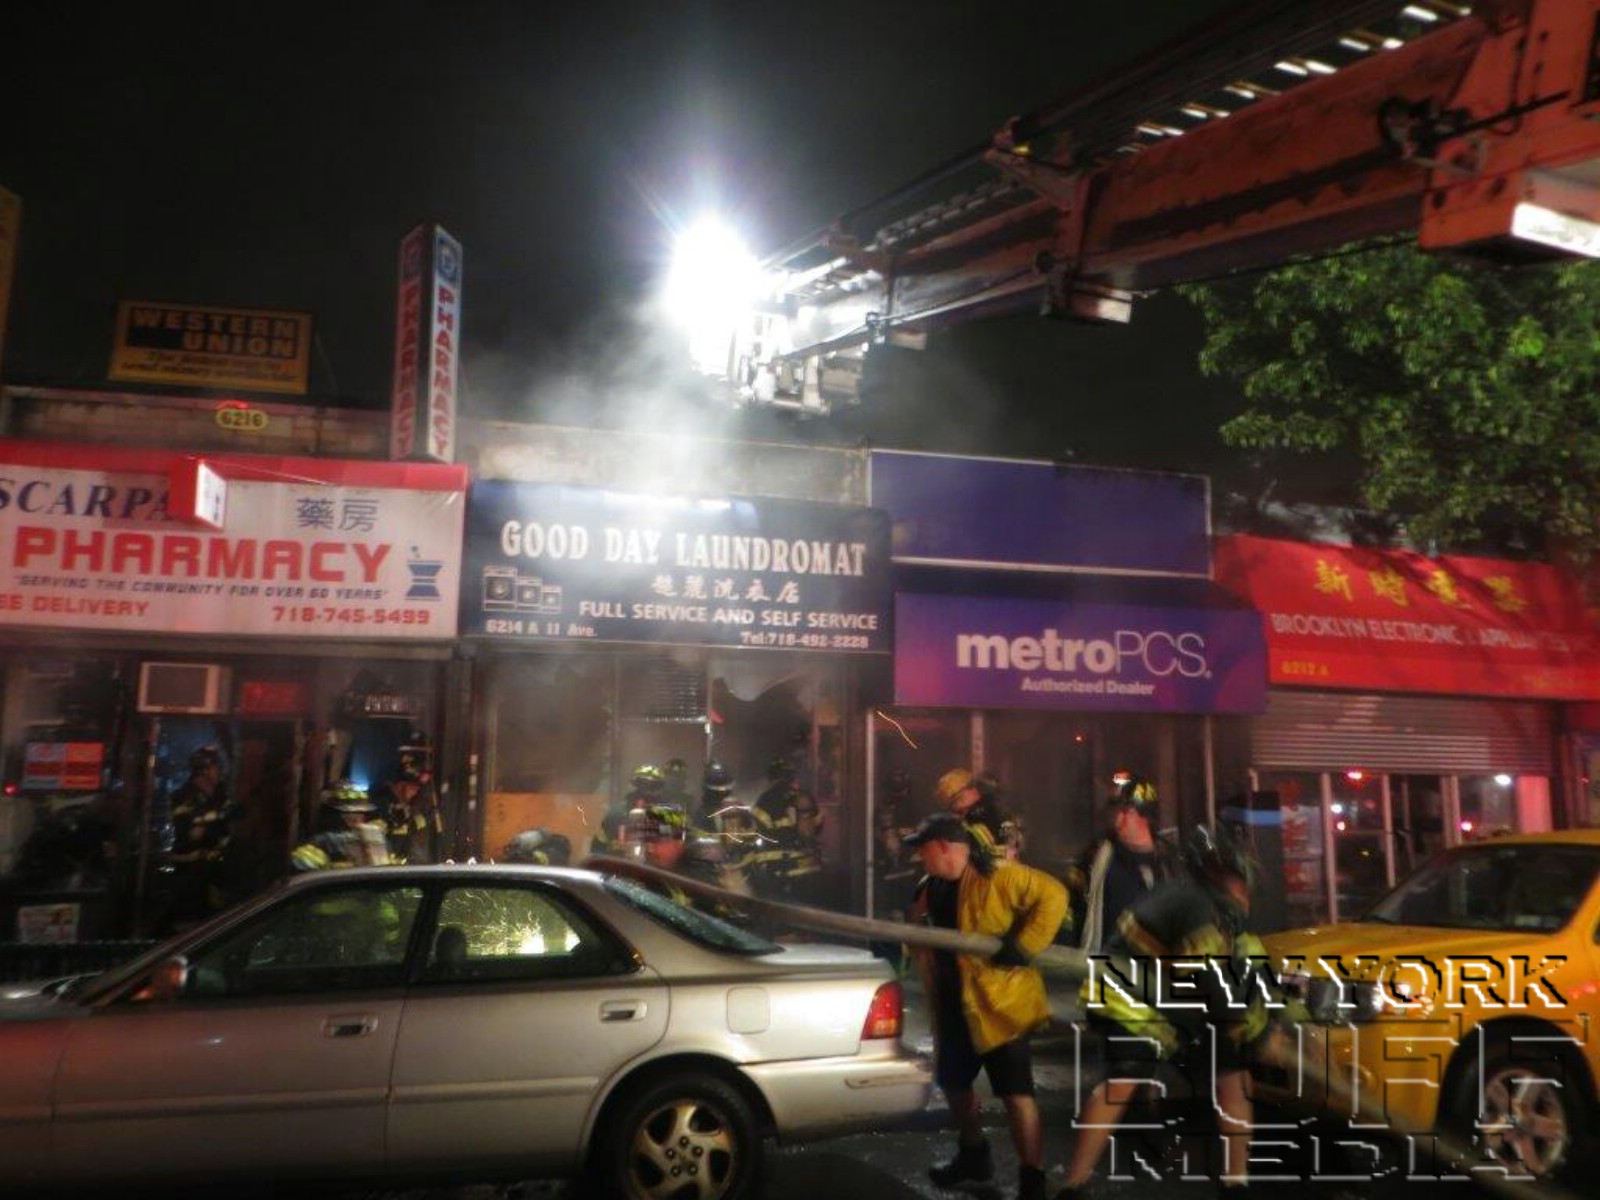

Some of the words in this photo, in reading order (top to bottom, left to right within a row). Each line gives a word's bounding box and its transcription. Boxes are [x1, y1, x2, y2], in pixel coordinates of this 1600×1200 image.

[133, 307, 297, 339] WESTERN
[183, 331, 297, 358] UNION
[434, 285, 455, 457] PHARMACY
[221, 410, 263, 428] 6216
[297, 498, 379, 532] 藥房
[14, 526, 392, 582] PHARMACY
[501, 520, 589, 559] GOOD
[604, 528, 661, 565] DAY
[675, 533, 867, 576] LAUNDROMAT
[97, 578, 128, 591] THE
[132, 581, 224, 597] COMMUNITY
[229, 585, 260, 598] FOR
[264, 586, 303, 599] OVER
[32, 596, 150, 617] DELIVERY
[272, 606, 431, 625] 718-745-5499
[579, 600, 625, 618] FULL
[632, 603, 707, 624] SERVICE
[713, 607, 755, 625] AND
[761, 609, 801, 627] SELF
[807, 612, 878, 631] SERVICE
[1270, 613, 1367, 638] BROOKLYN
[956, 628, 1207, 677] metroPCS
[1021, 677, 1104, 694] Authorized
[1106, 679, 1155, 696] Dealer
